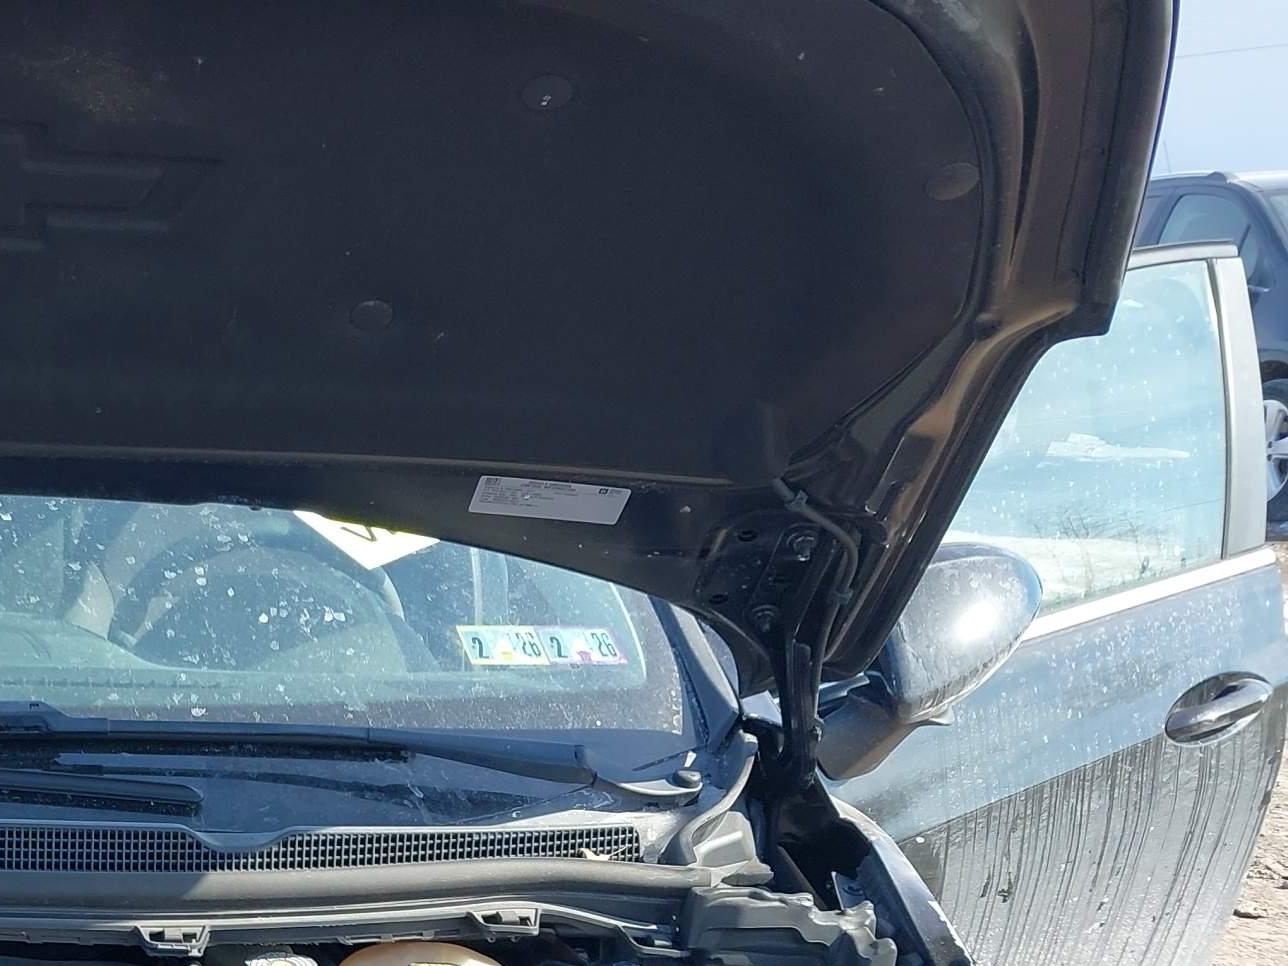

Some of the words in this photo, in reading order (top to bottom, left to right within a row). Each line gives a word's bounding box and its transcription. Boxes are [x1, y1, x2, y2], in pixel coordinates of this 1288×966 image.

[471, 637, 490, 659] 2
[515, 632, 542, 657] 26
[549, 636, 569, 659] 2
[590, 632, 618, 657] 26
